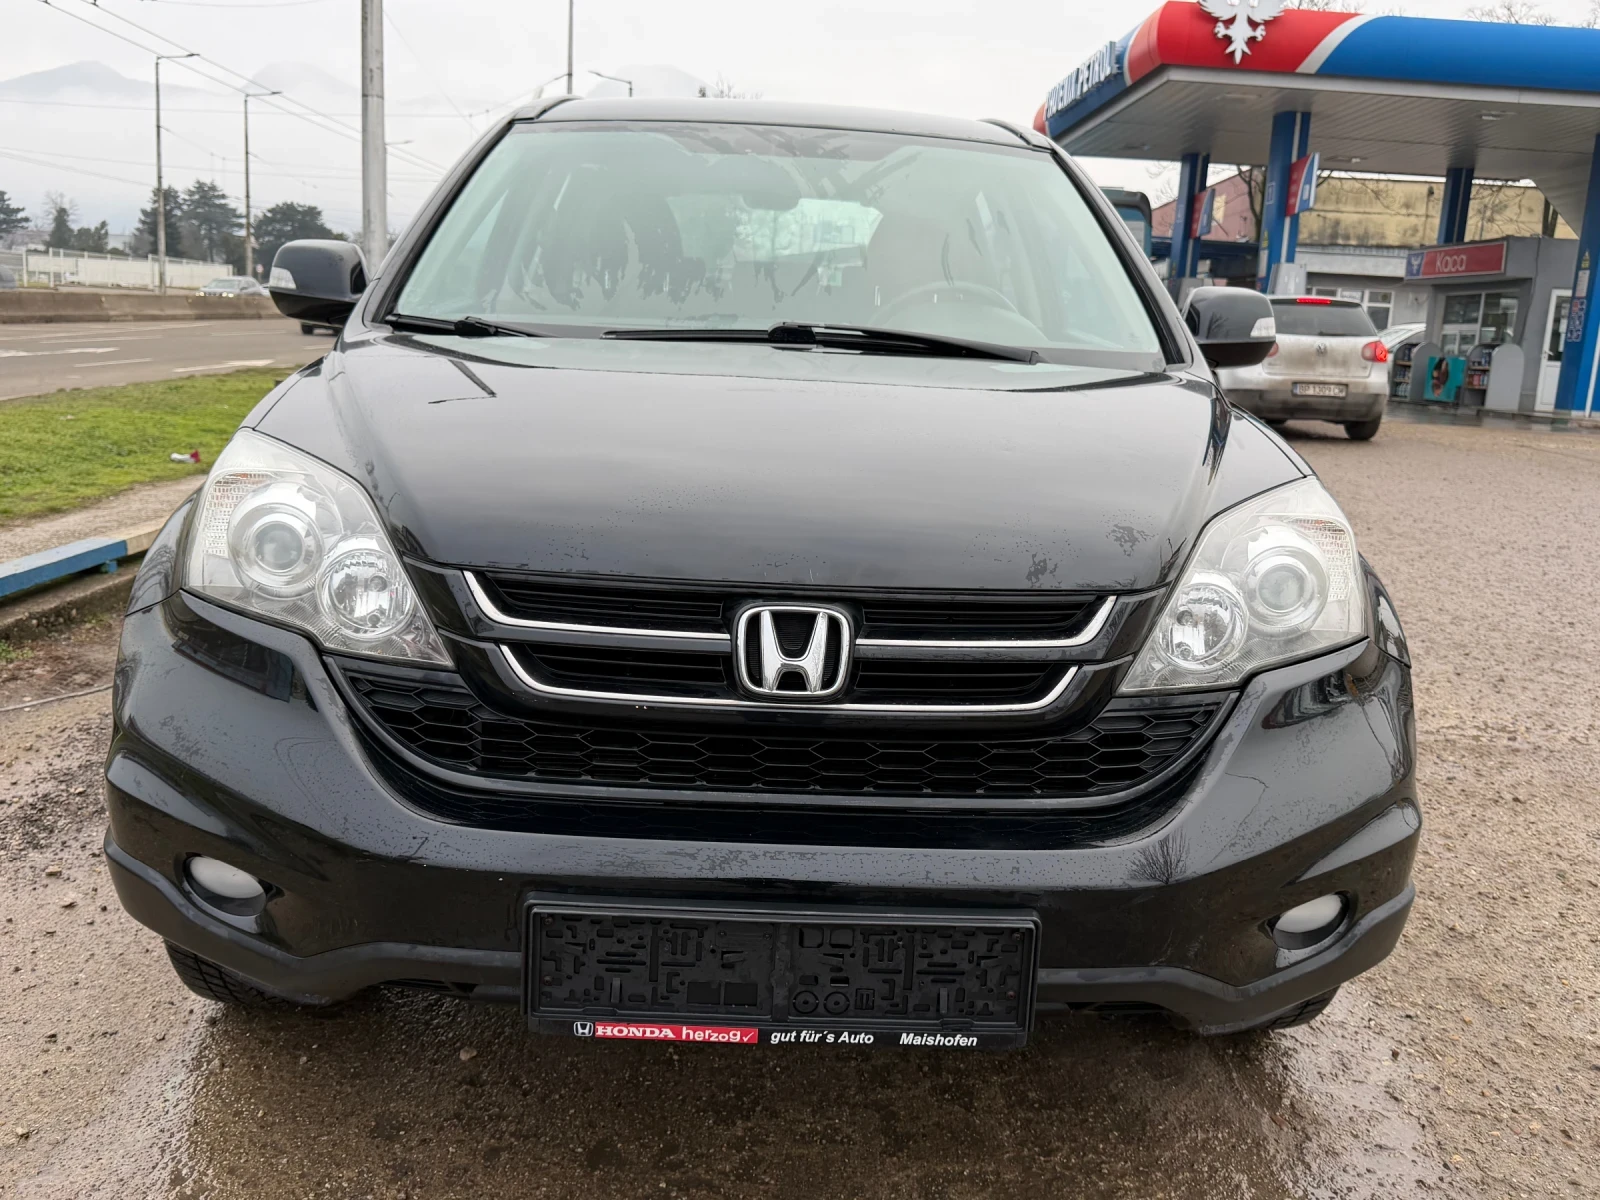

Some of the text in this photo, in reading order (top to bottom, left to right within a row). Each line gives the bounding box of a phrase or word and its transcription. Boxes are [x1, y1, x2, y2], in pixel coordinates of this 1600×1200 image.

[1078, 41, 1116, 99] PETROL
[1435, 252, 1467, 273] Каса
[596, 1025, 676, 1038] HONDA
[682, 1026, 741, 1042] herzog
[770, 1031, 797, 1044] gut
[838, 1031, 874, 1044] Auto
[899, 1032, 978, 1047] Maishofen
